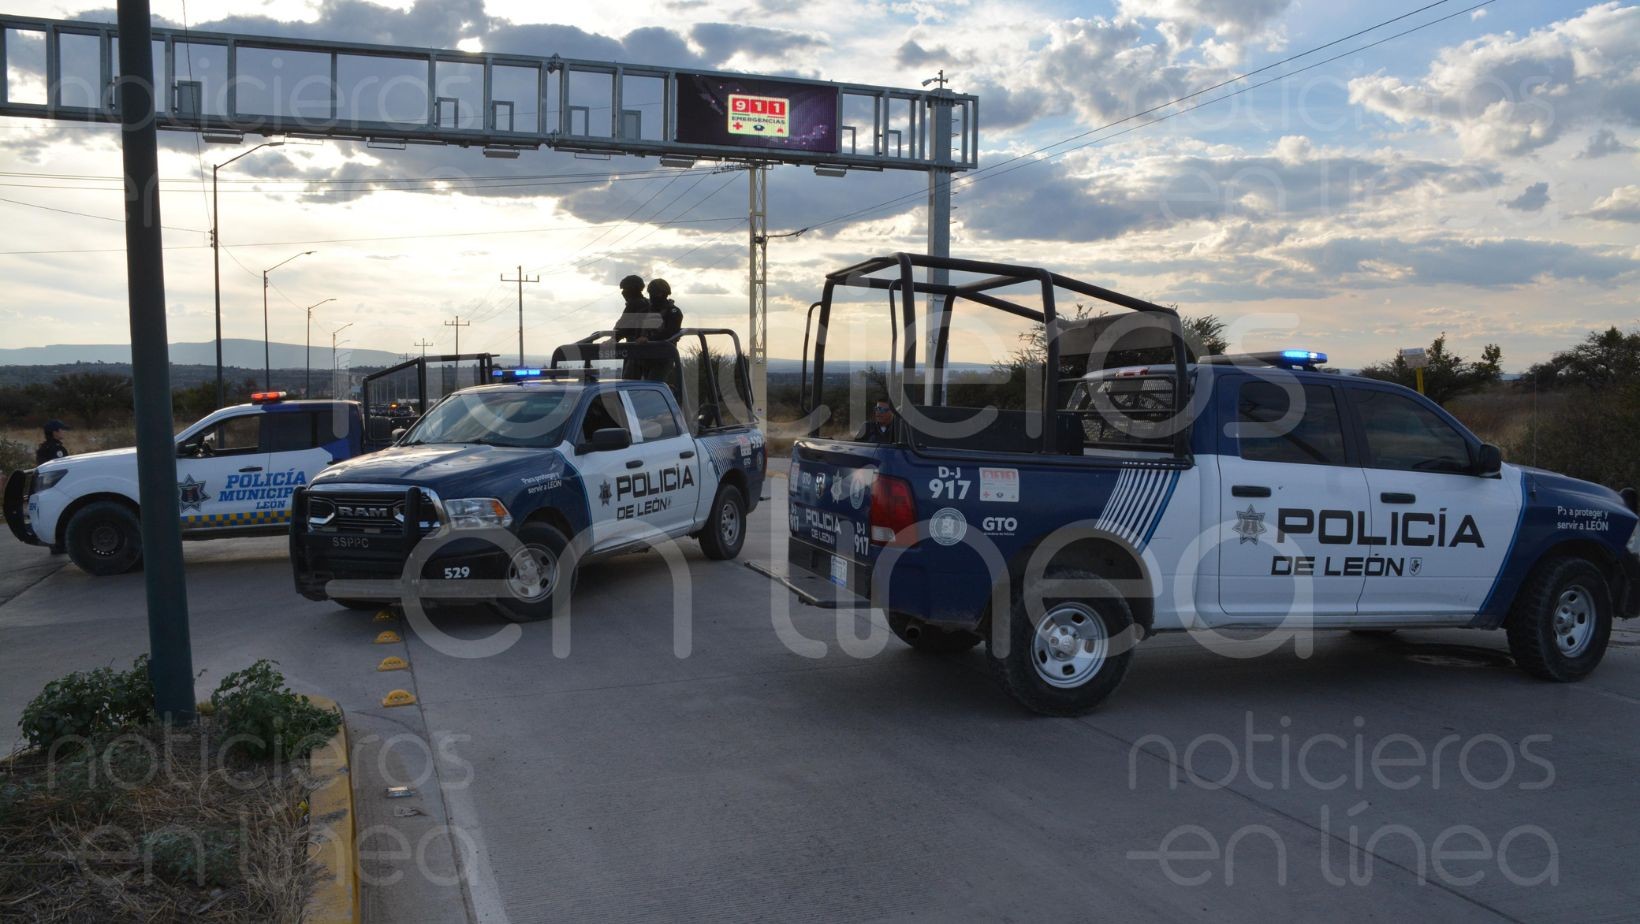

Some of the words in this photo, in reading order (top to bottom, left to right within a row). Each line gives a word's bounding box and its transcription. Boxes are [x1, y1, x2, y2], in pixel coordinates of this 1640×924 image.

[736, 100, 780, 113] 911
[732, 116, 785, 124] EMERGENCIAS
[226, 468, 307, 488] POLICÍA
[938, 466, 961, 479] D-J
[616, 463, 694, 501] POLICÍA
[929, 478, 972, 500] 917
[218, 486, 294, 502] MUNICIP
[256, 499, 286, 509] LEÓN
[338, 506, 387, 517] RAM
[617, 505, 634, 520] DE
[637, 497, 668, 516] LEÓN
[982, 517, 1018, 532] GTO
[1276, 508, 1485, 548] POLICÍA
[1557, 520, 1578, 529] servir
[1585, 519, 1609, 531] LEÓN
[332, 537, 369, 548] SSPPC
[854, 534, 869, 556] 917
[1271, 556, 1315, 576] DE
[1324, 553, 1405, 577] LEÓN
[444, 567, 470, 579] 529
